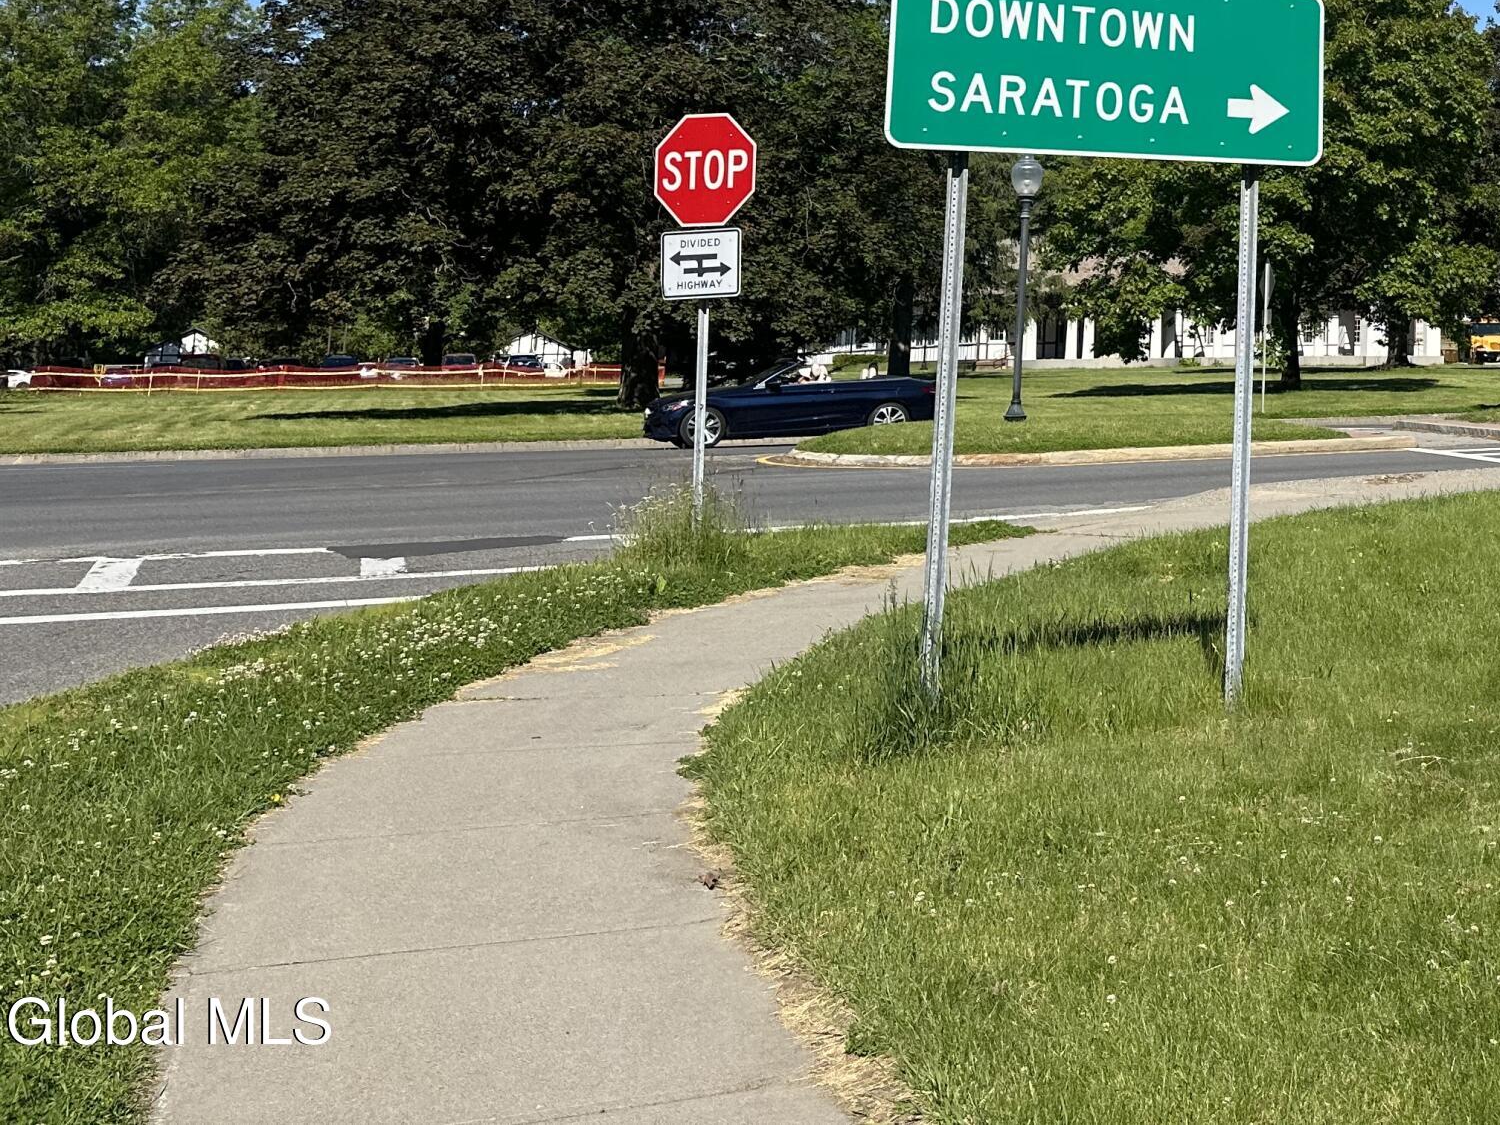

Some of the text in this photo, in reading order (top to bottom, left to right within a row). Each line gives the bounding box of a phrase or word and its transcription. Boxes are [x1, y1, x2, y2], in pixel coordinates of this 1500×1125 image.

[927, 71, 1190, 125] SARATOGA
[662, 148, 749, 192] STOP
[680, 238, 721, 249] DIVIDED
[677, 279, 723, 290] HIGHWAY
